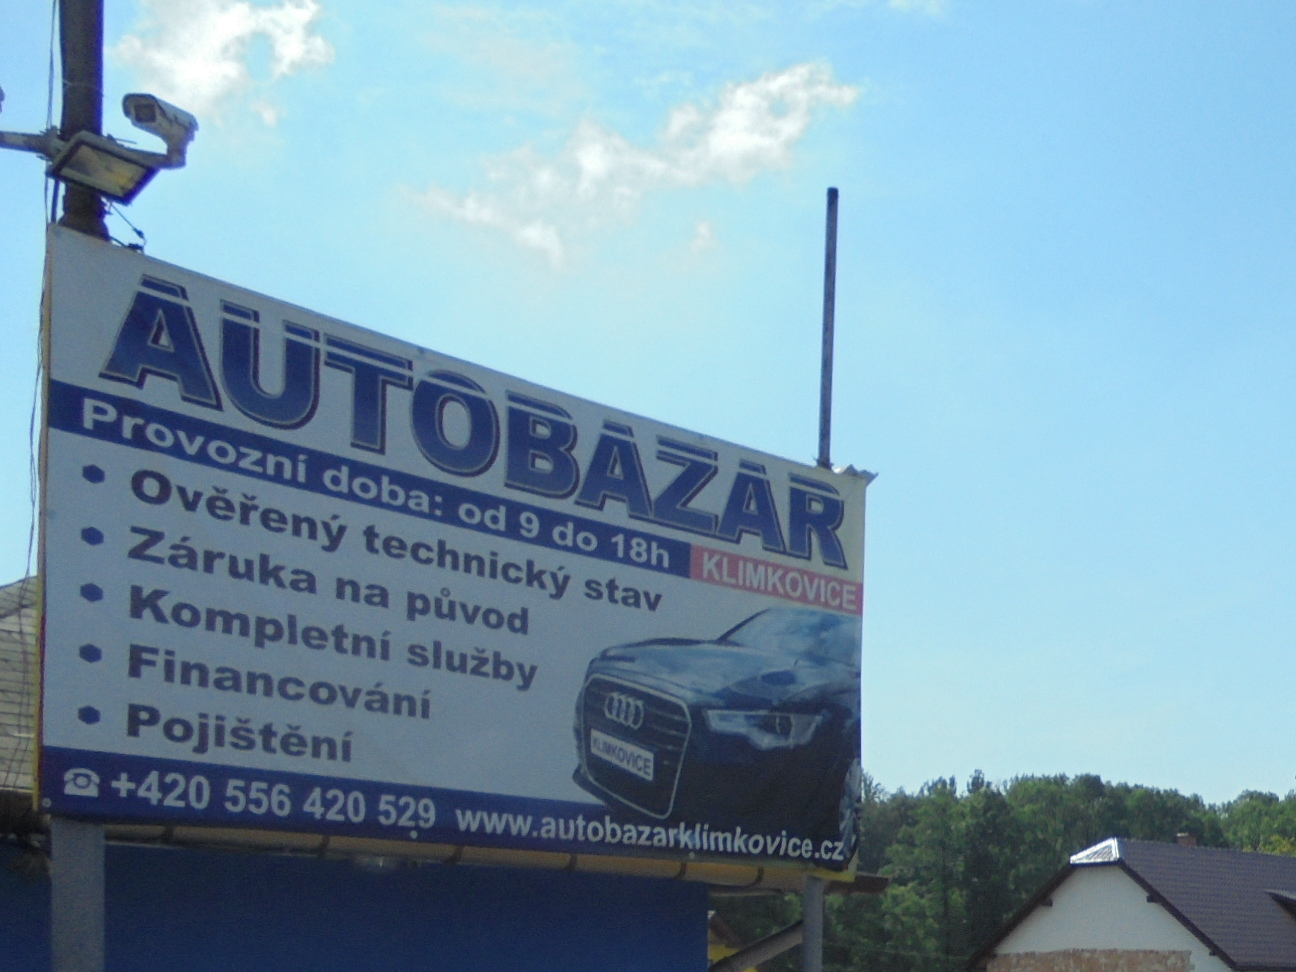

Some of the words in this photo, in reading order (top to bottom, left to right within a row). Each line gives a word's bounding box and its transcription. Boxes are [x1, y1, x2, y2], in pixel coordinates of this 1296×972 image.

[98, 274, 848, 569] AUTOBAZAR
[82, 398, 309, 483] Provozní
[323, 465, 443, 517] doba:
[458, 503, 506, 531] od
[519, 511, 540, 538] 9
[552, 521, 598, 552] do
[611, 534, 669, 568] 18h
[127, 525, 317, 595] Záruka
[335, 577, 389, 609] na
[407, 587, 529, 635] původ
[131, 469, 347, 553] Ověřený
[363, 524, 571, 599] technický
[584, 577, 662, 612] stav
[702, 551, 857, 610] KLIMKOVICE
[128, 643, 430, 719] Financování
[129, 584, 391, 661] Kompletní
[407, 640, 538, 691] služby
[127, 703, 353, 762] Pojištění
[592, 736, 651, 776] KLIMKOVICE
[111, 770, 210, 810] +420
[224, 779, 291, 817] 556
[302, 787, 366, 823] 420
[378, 794, 436, 829] 529
[455, 809, 844, 861] www.autobazarklimkovice.cz
